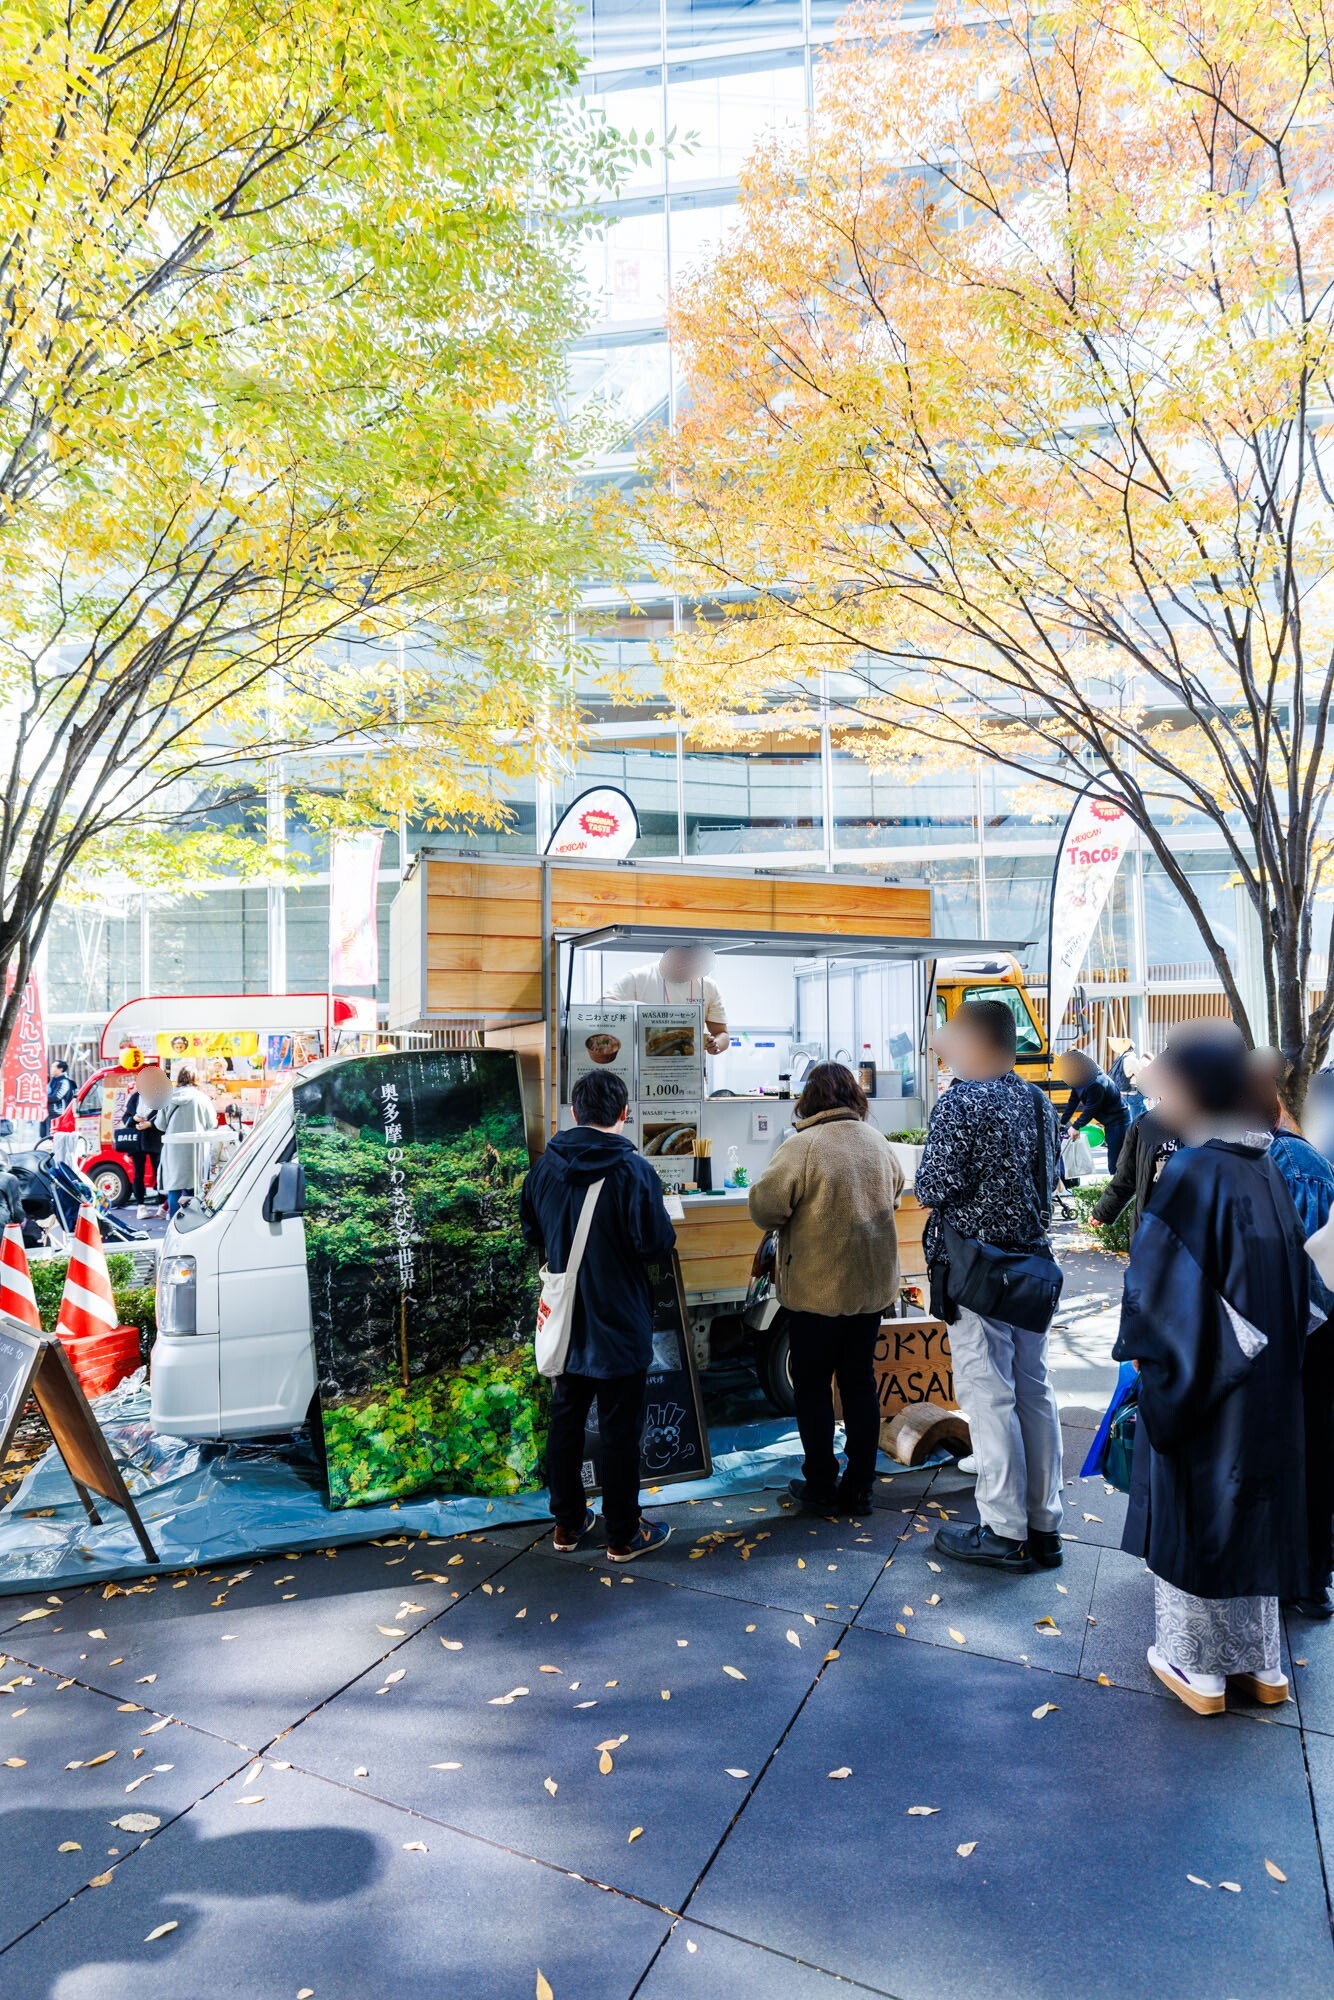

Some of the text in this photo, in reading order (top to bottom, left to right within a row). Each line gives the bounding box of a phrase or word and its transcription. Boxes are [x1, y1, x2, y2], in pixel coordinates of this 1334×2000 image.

[588, 823, 611, 833] TASTE
[1071, 827, 1102, 845] MEXICAN
[555, 841, 588, 854] MEXICAN
[1066, 846, 1119, 865] Tacos
[380, 1083, 418, 1304] 奥多摩のわさびを世界へ
